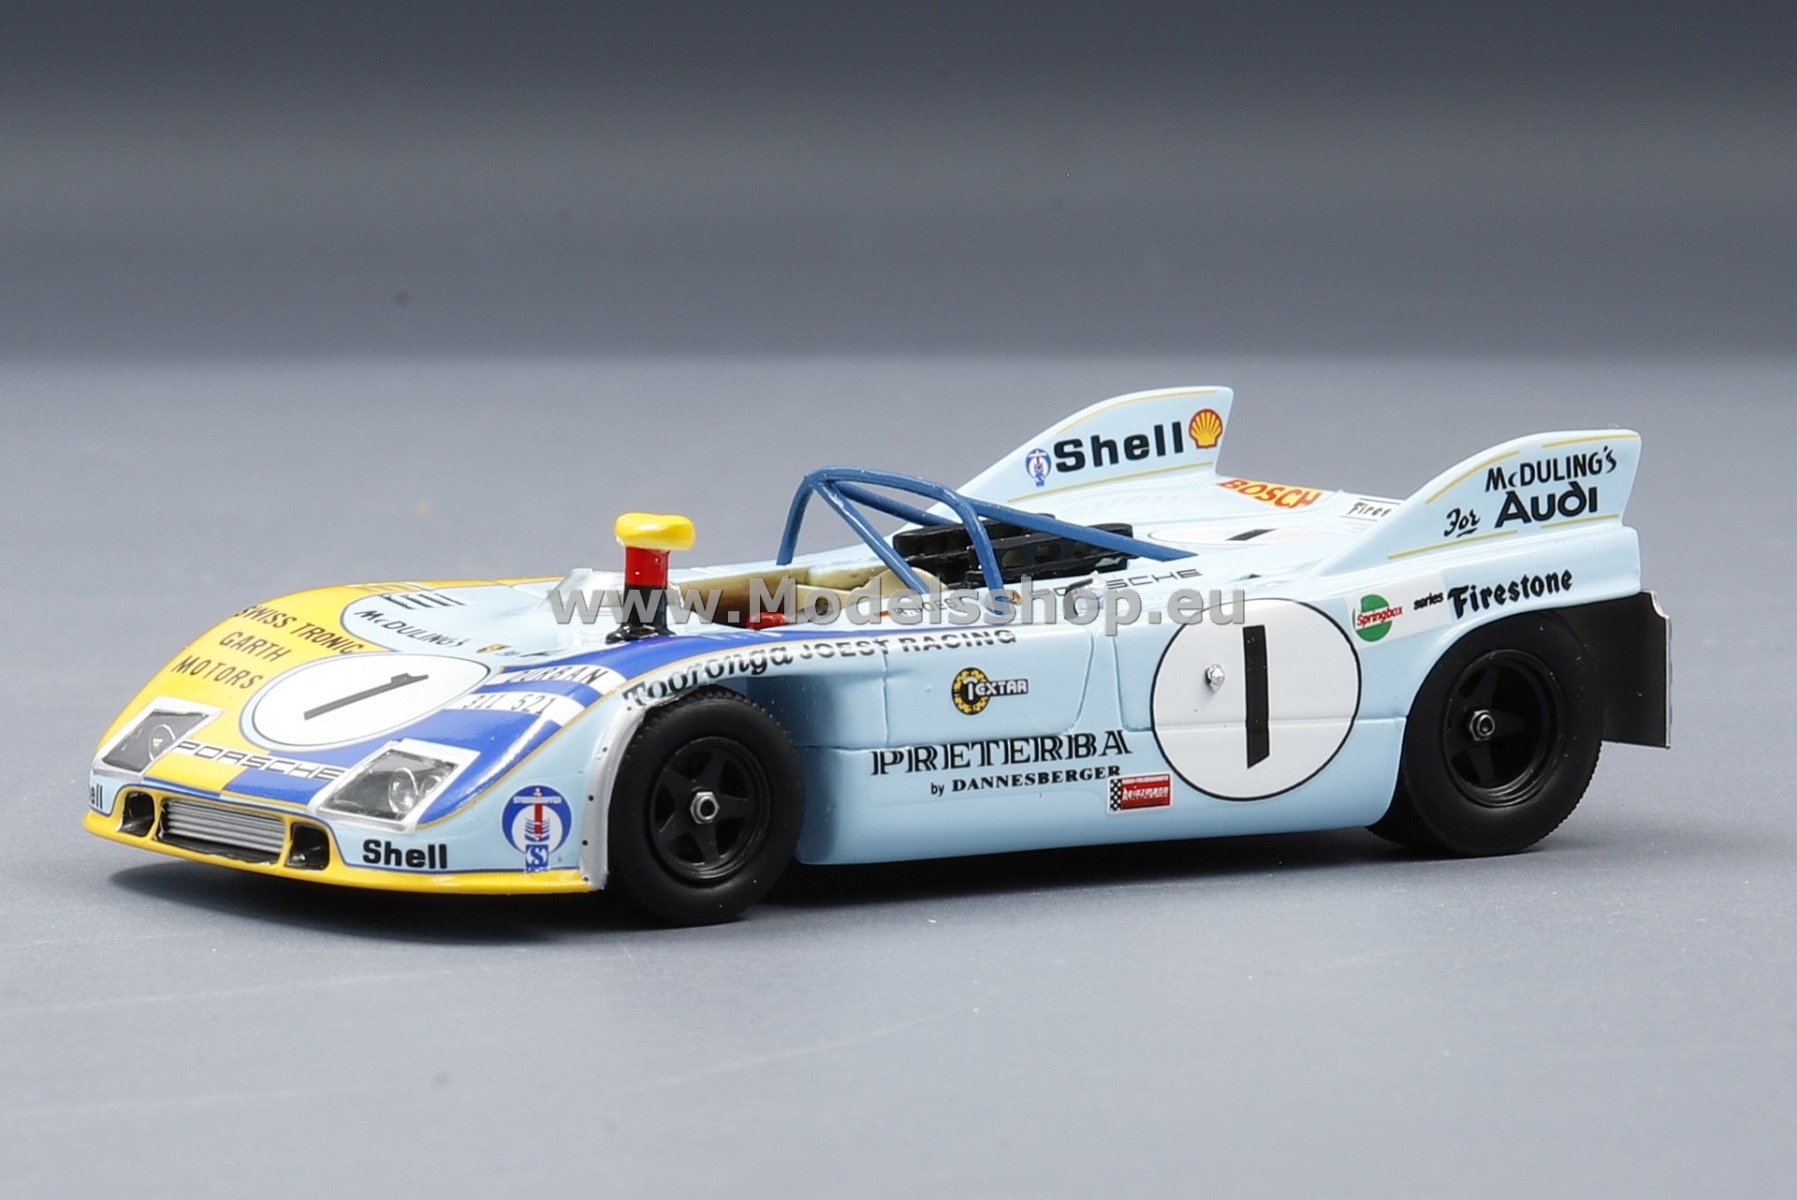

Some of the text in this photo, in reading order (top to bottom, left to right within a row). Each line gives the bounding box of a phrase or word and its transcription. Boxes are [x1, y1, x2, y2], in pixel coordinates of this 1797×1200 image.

[1053, 421, 1184, 473] Shell
[1216, 479, 1323, 509] BOSCH
[1443, 481, 1598, 537] For Audi
[1356, 592, 1444, 628] Springbox series
[1447, 569, 1573, 619] Firestone
[219, 631, 292, 662] GARTH
[234, 605, 364, 654] SWISS TRONIC
[171, 655, 263, 689] MOTORS
[622, 630, 1017, 706] Tooronga JOEST RACING
[304, 673, 428, 720] 1
[1243, 625, 1270, 769] 1
[175, 740, 346, 782] PORSCHE
[870, 730, 1133, 776] PRETERBA
[930, 765, 1121, 798] by DANNESBERGER
[362, 839, 448, 869] Shell
